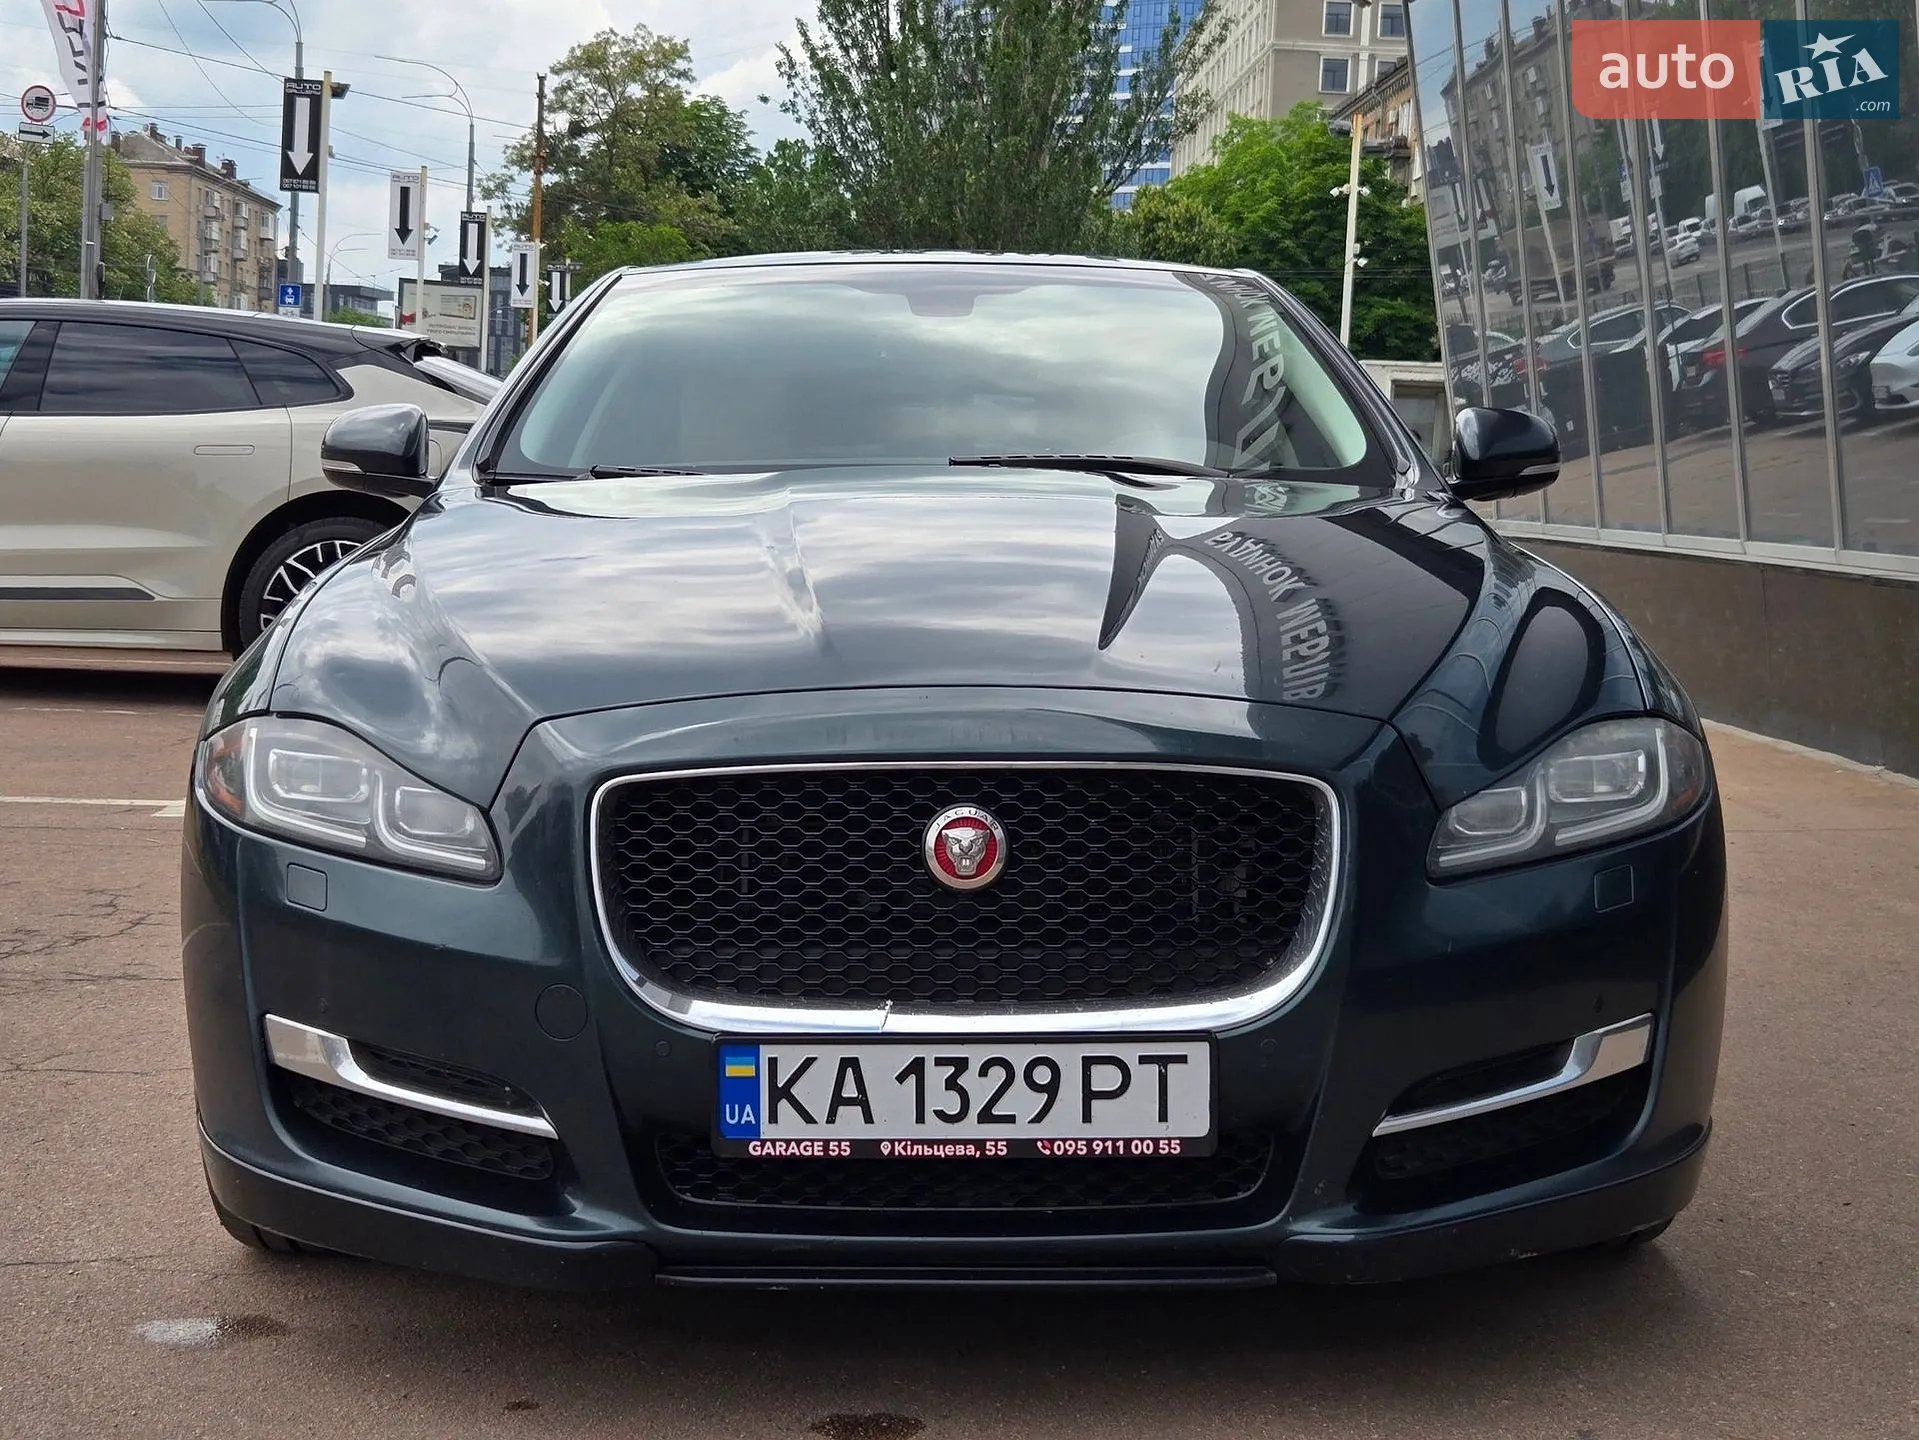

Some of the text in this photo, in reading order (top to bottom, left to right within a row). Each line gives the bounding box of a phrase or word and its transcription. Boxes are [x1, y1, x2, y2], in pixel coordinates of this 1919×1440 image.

[286, 82, 322, 90] AUTO
[935, 808, 1000, 832] JAGUAR
[767, 1054, 1189, 1125] KA 1329 PT
[725, 1103, 756, 1125] UA
[748, 1141, 851, 1156] GARAGE 55
[894, 1140, 1008, 1158] Кільцева, 55
[1053, 1139, 1181, 1155] 095 911 00 55
